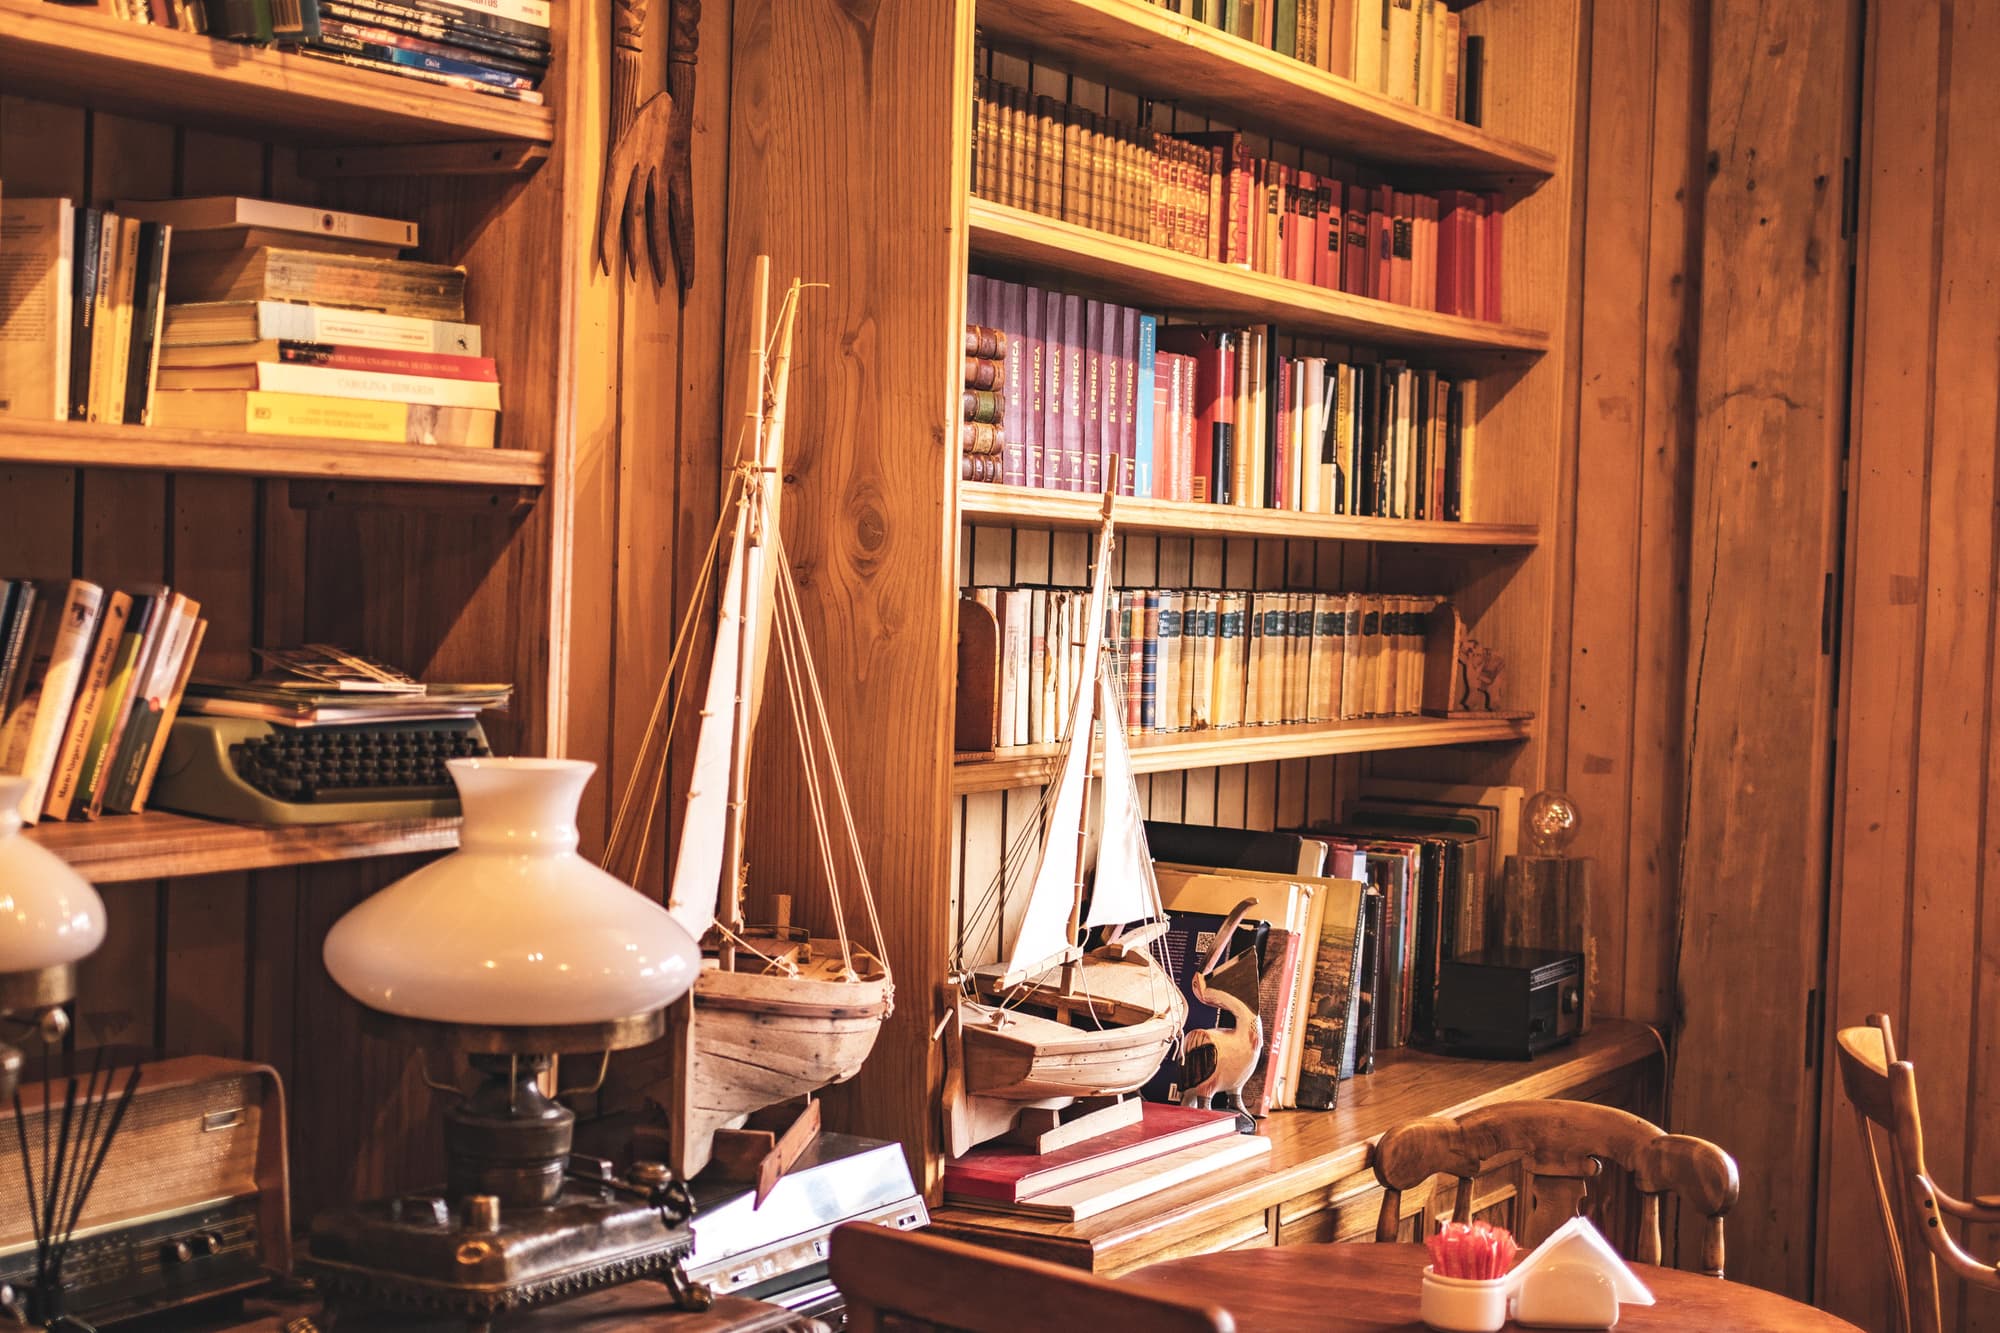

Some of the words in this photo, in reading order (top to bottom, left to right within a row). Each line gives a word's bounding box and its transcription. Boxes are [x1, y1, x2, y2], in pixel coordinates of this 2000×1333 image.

[1011, 392, 1018, 406] EL
[1034, 397, 1040, 411] EL
[1052, 400, 1059, 413] EL
[1072, 403, 1079, 416] EL
[1090, 407, 1097, 420] EL
[1109, 409, 1116, 423] EL
[1126, 411, 1132, 423] EL
